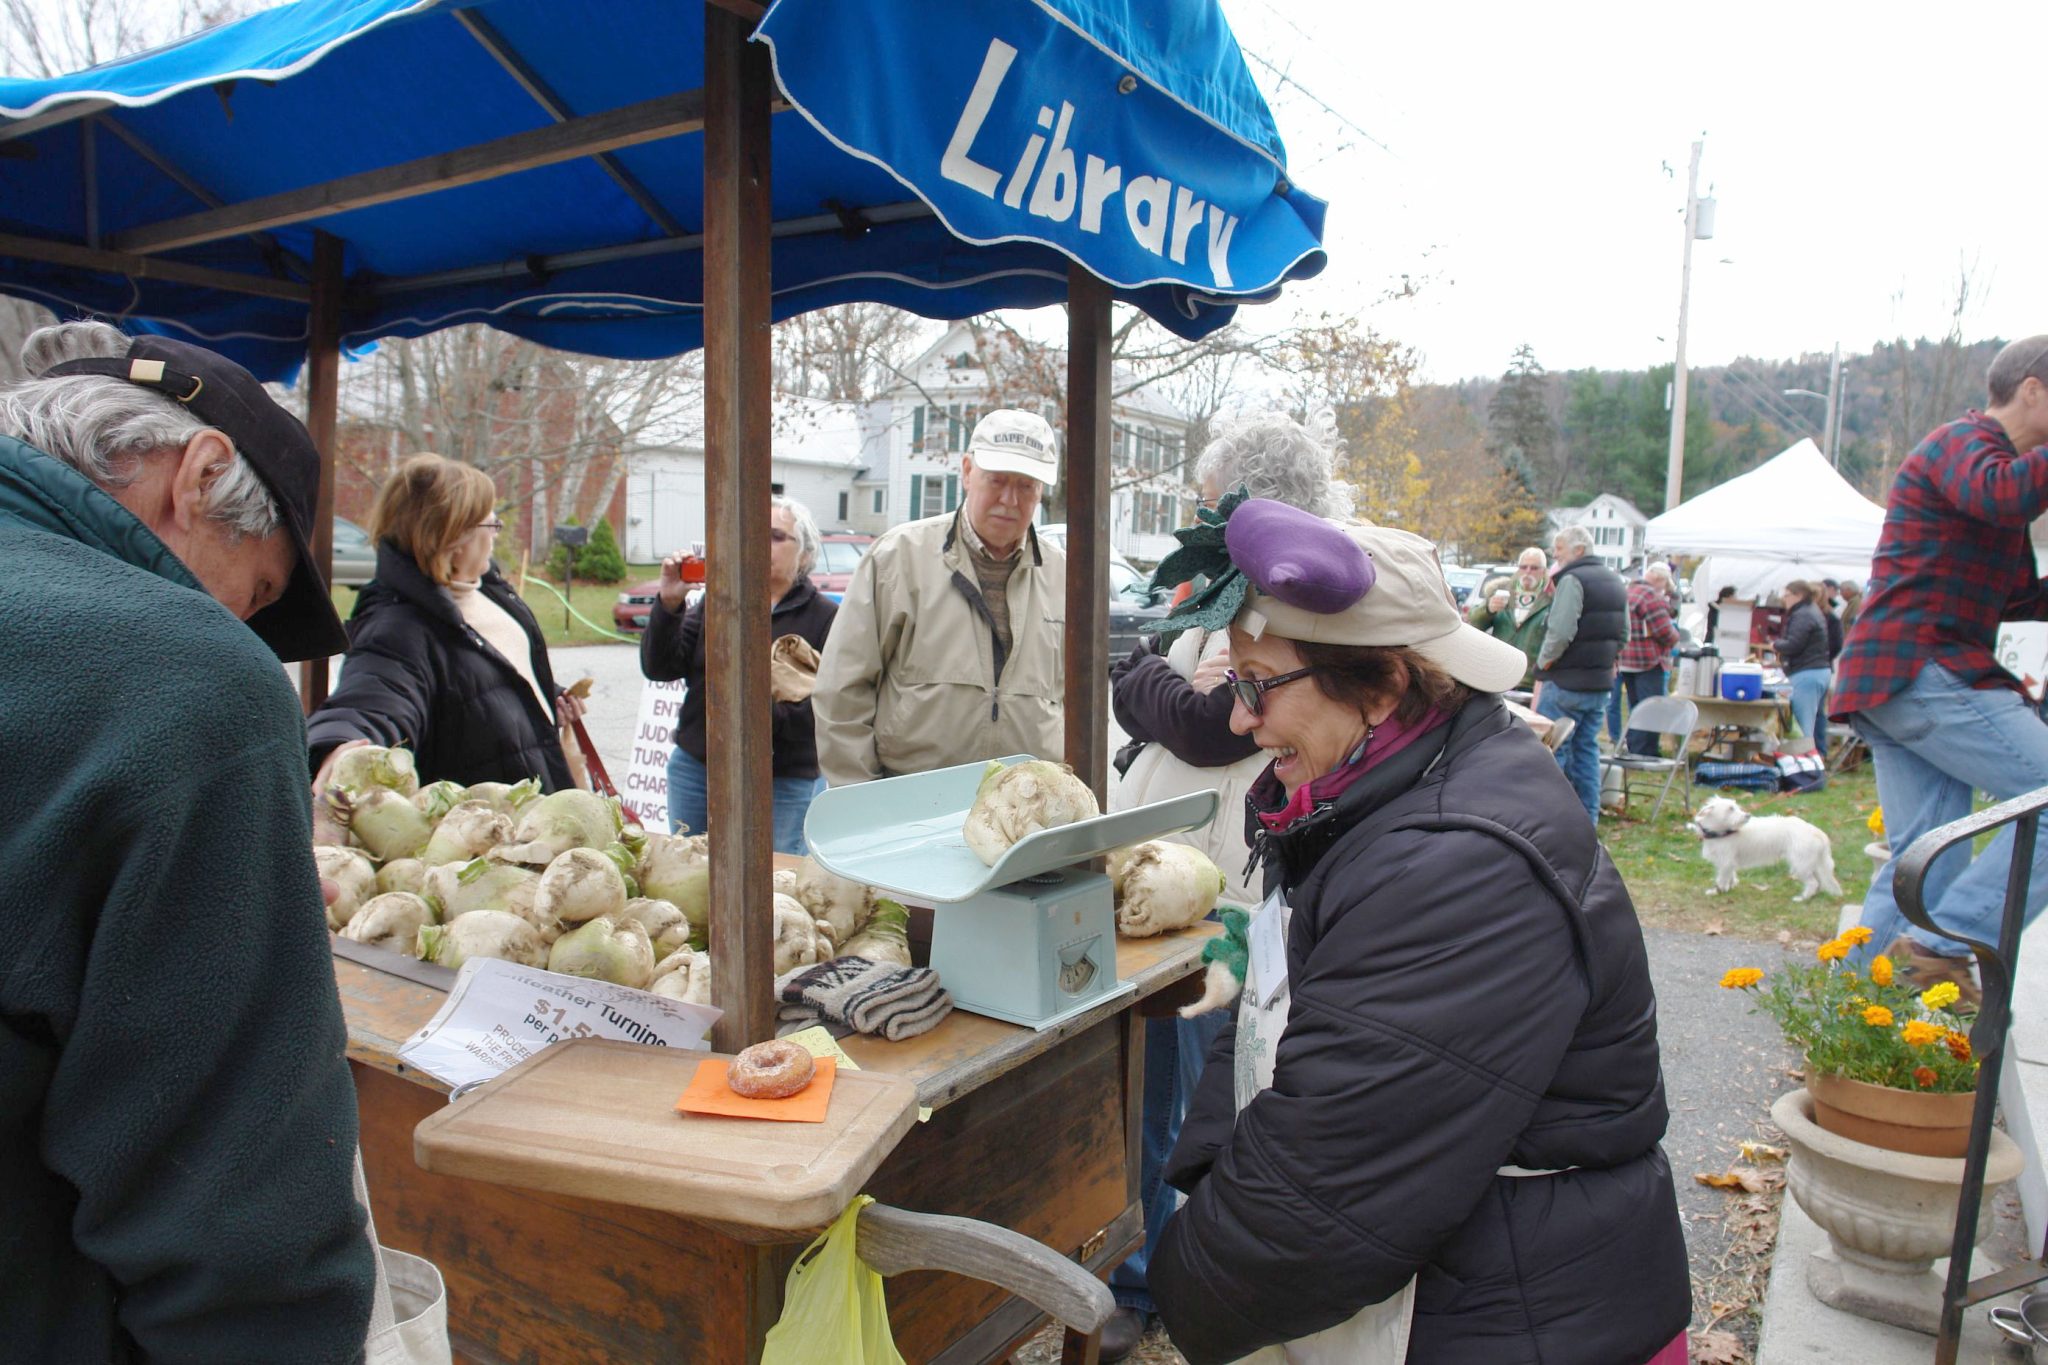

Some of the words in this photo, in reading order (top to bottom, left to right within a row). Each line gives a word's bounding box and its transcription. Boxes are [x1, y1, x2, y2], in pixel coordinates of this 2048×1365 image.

[941, 37, 1238, 288] Library
[993, 433, 1024, 443] CAPE
[523, 1013, 550, 1033] per
[534, 998, 604, 1038] $1.5
[481, 1033, 502, 1054] THE
